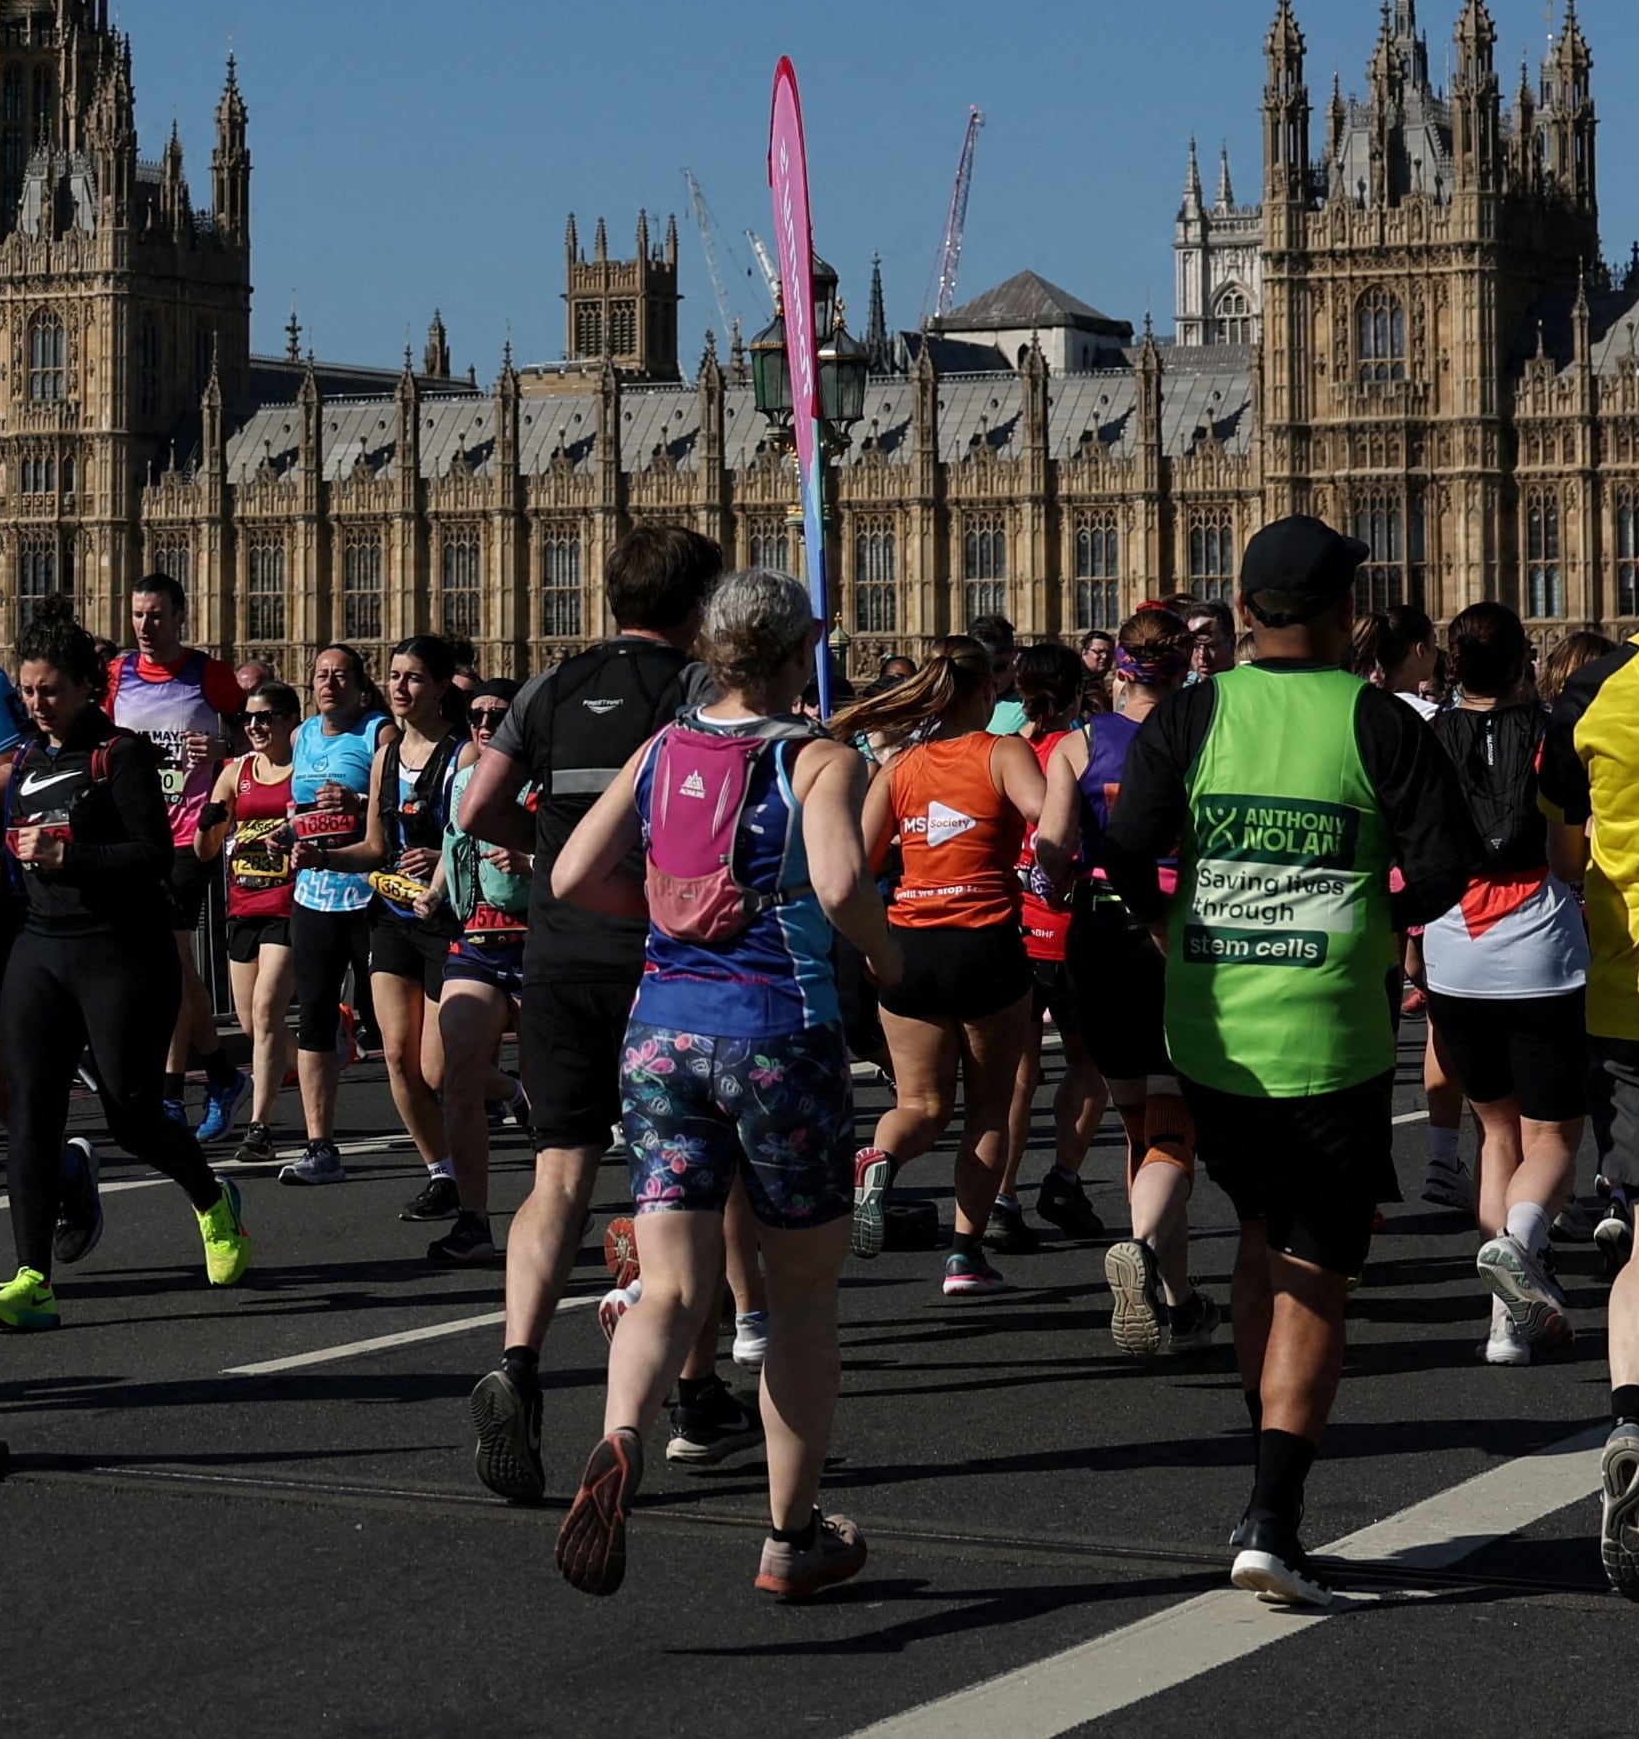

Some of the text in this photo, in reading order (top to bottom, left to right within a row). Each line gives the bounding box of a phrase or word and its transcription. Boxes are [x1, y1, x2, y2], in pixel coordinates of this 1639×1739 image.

[903, 817, 971, 834] MS Society
[1244, 807, 1347, 834] ANTHONY
[1242, 826, 1341, 857] NOLAN
[918, 889, 934, 897] we
[937, 885, 963, 896] stop
[1198, 867, 1346, 897] Saving lives
[1193, 898, 1294, 925] through
[1190, 936, 1319, 959] stem cells
